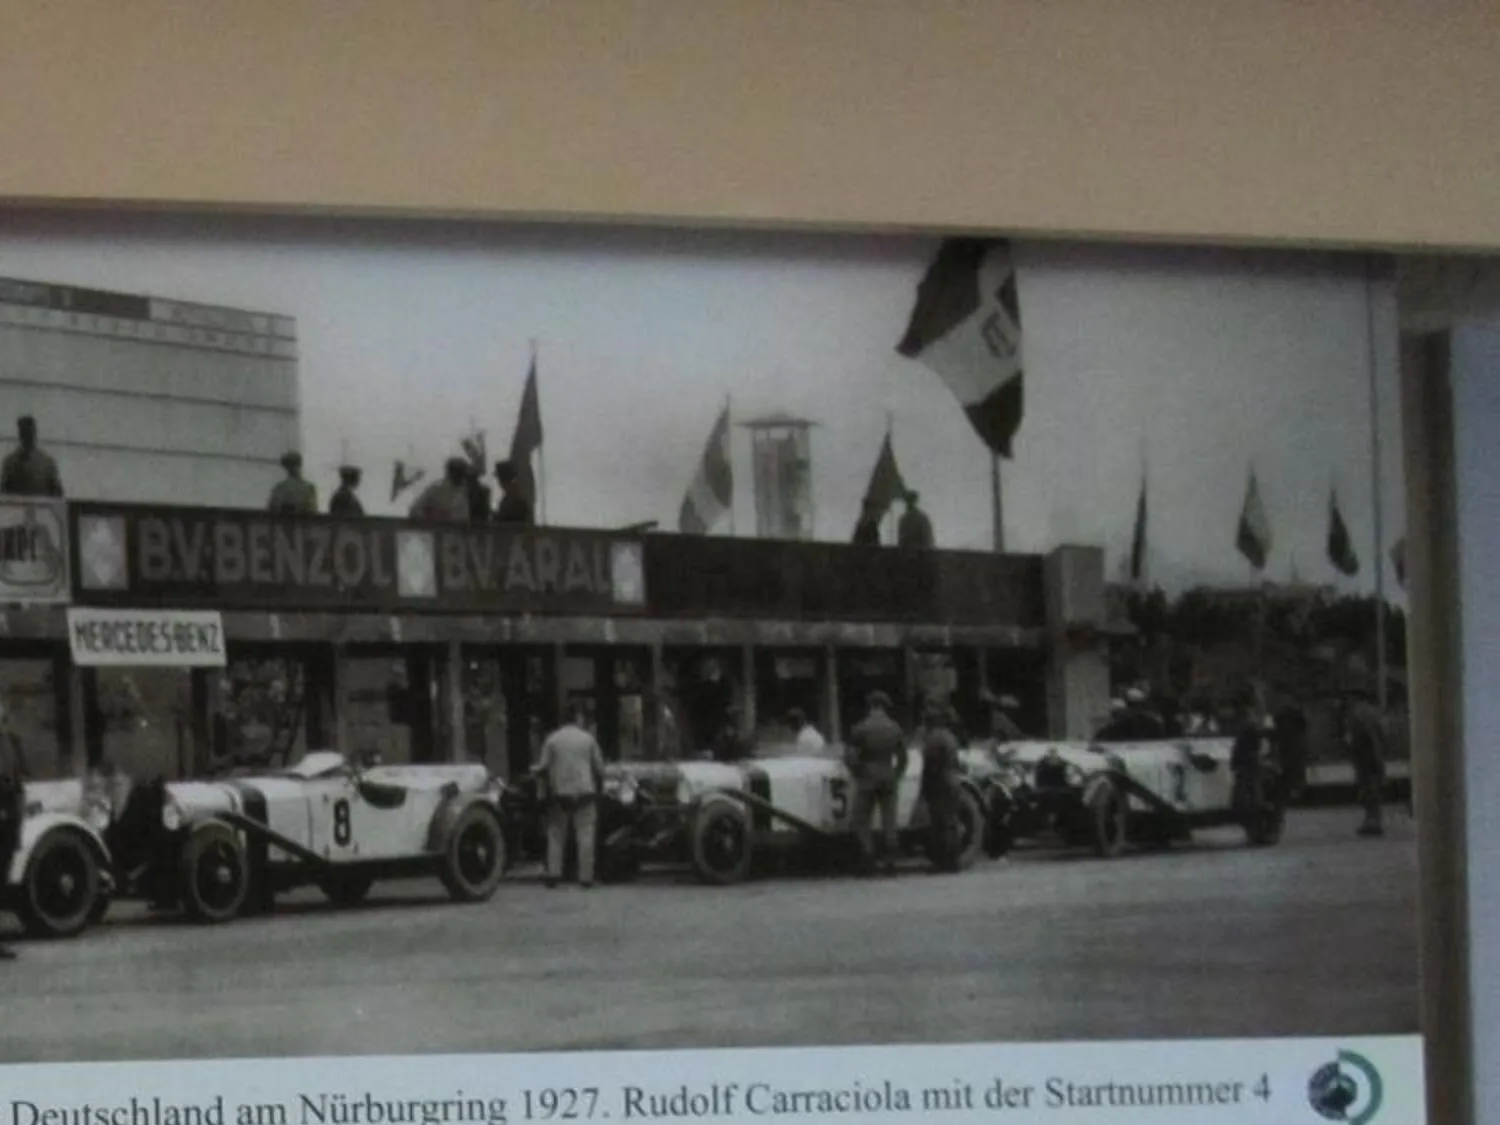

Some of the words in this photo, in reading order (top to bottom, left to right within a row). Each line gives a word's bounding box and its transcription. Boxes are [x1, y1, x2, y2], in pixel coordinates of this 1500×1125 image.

[74, 618, 221, 655] MERCEDES-BENZ
[332, 798, 352, 848] 8
[523, 1087, 610, 1121] 1927.
[623, 1083, 739, 1119] Rudolf
[744, 1080, 912, 1115] Carraciola
[922, 1084, 974, 1110] mit
[983, 1078, 1035, 1109] der
[1045, 1077, 1243, 1108] Startnummer
[1253, 1073, 1272, 1102] 4
